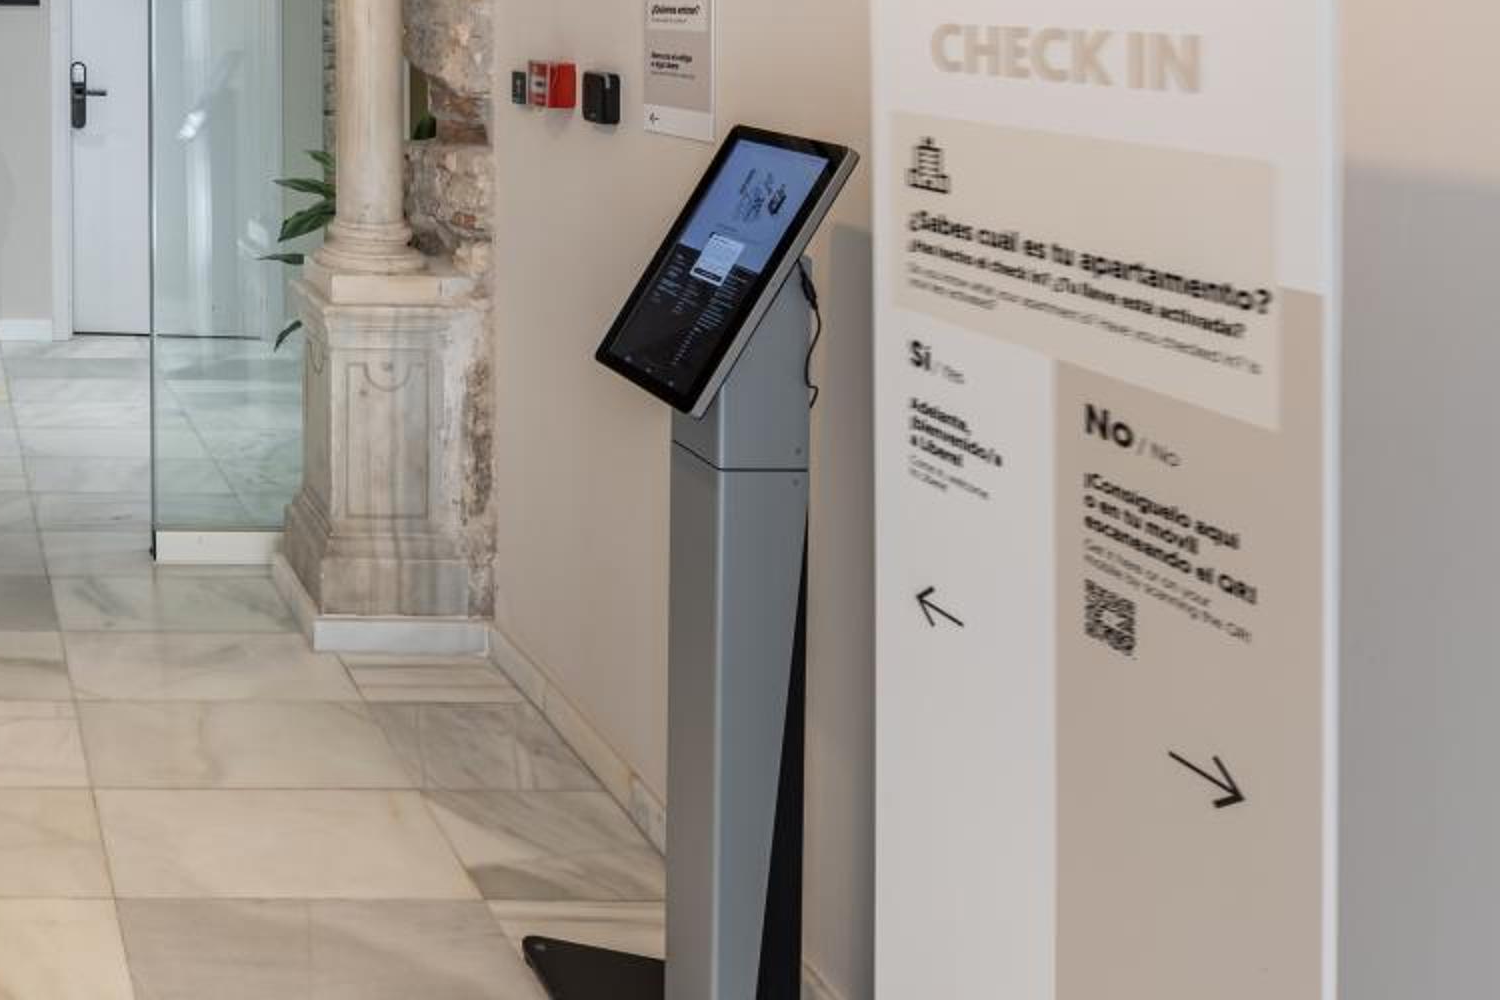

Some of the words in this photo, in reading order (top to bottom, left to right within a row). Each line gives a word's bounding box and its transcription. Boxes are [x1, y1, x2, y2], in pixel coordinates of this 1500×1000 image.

[931, 23, 1111, 87] CHECK
[1125, 31, 1203, 94] IN
[909, 210, 972, 241] ¿Sabes
[1023, 239, 1045, 259] es
[1051, 243, 1075, 267] tu
[1080, 252, 1272, 315] apartamento?
[1084, 402, 1133, 448] No
[1084, 495, 1096, 508] o
[1100, 501, 1121, 520] en
[1123, 508, 1142, 530] tu
[1196, 567, 1215, 585] el
